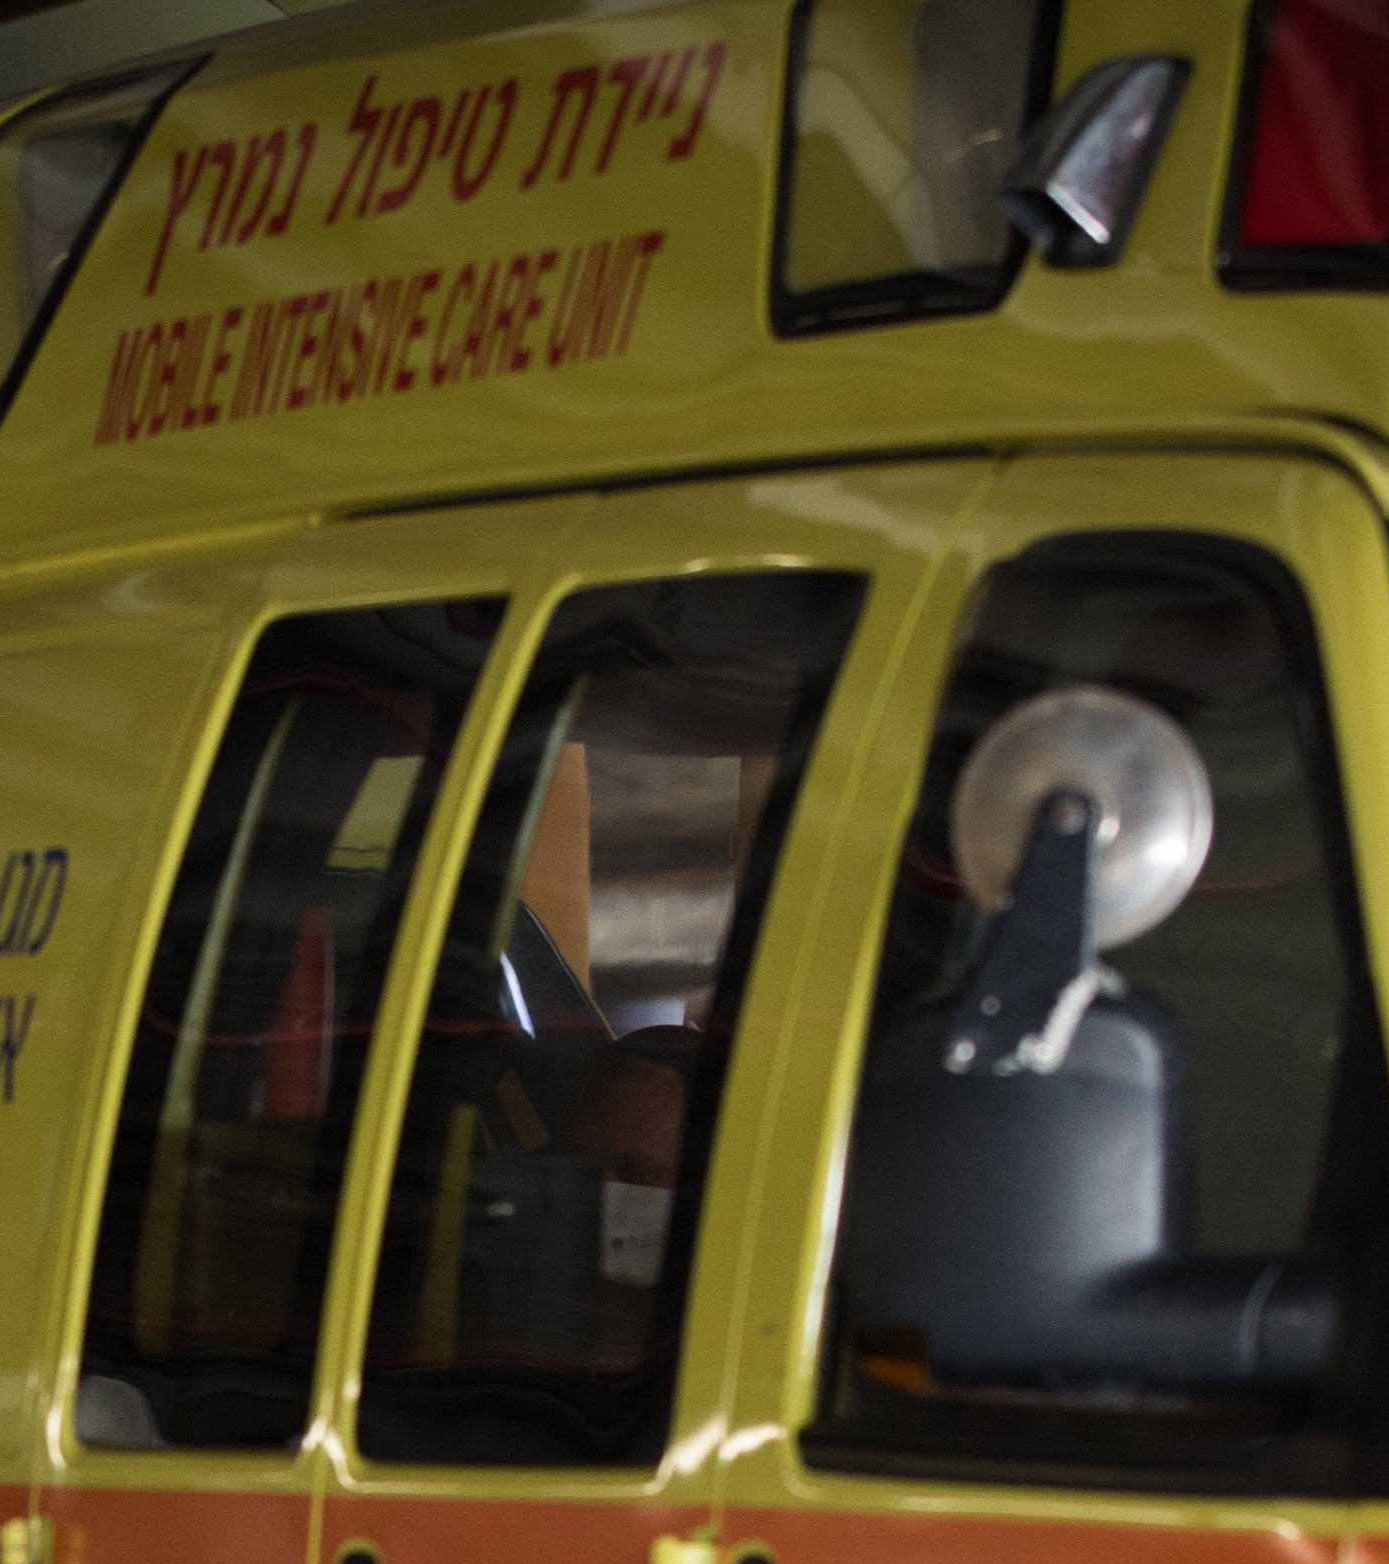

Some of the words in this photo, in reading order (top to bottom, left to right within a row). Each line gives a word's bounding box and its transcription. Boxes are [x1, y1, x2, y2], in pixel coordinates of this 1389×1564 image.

[323, 74, 519, 226] טיפול
[521, 40, 727, 192] ניידת
[144, 122, 318, 298] נמרץ
[94, 307, 244, 447] MOBILE
[227, 268, 442, 422] INTENSIVE
[428, 246, 559, 388] CARE
[545, 229, 667, 370] UNIT
